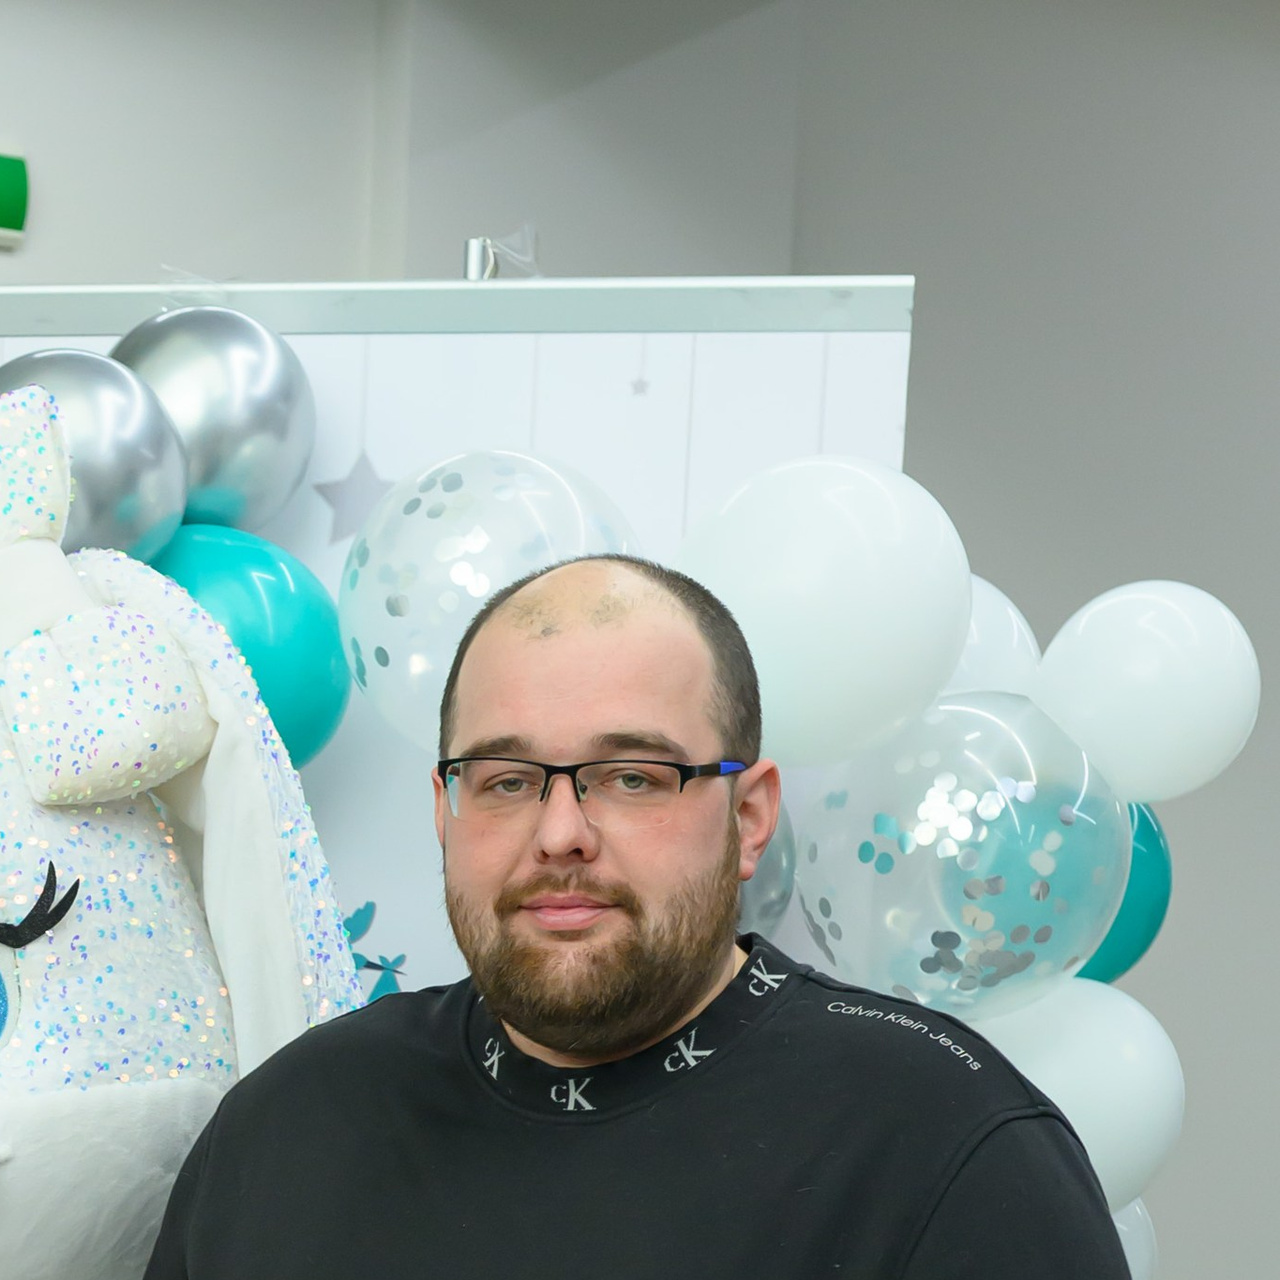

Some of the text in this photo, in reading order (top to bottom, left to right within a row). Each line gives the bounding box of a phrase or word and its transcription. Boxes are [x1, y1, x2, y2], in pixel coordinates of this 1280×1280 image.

[827, 1002, 982, 1071] Calvin Klein Jeans
